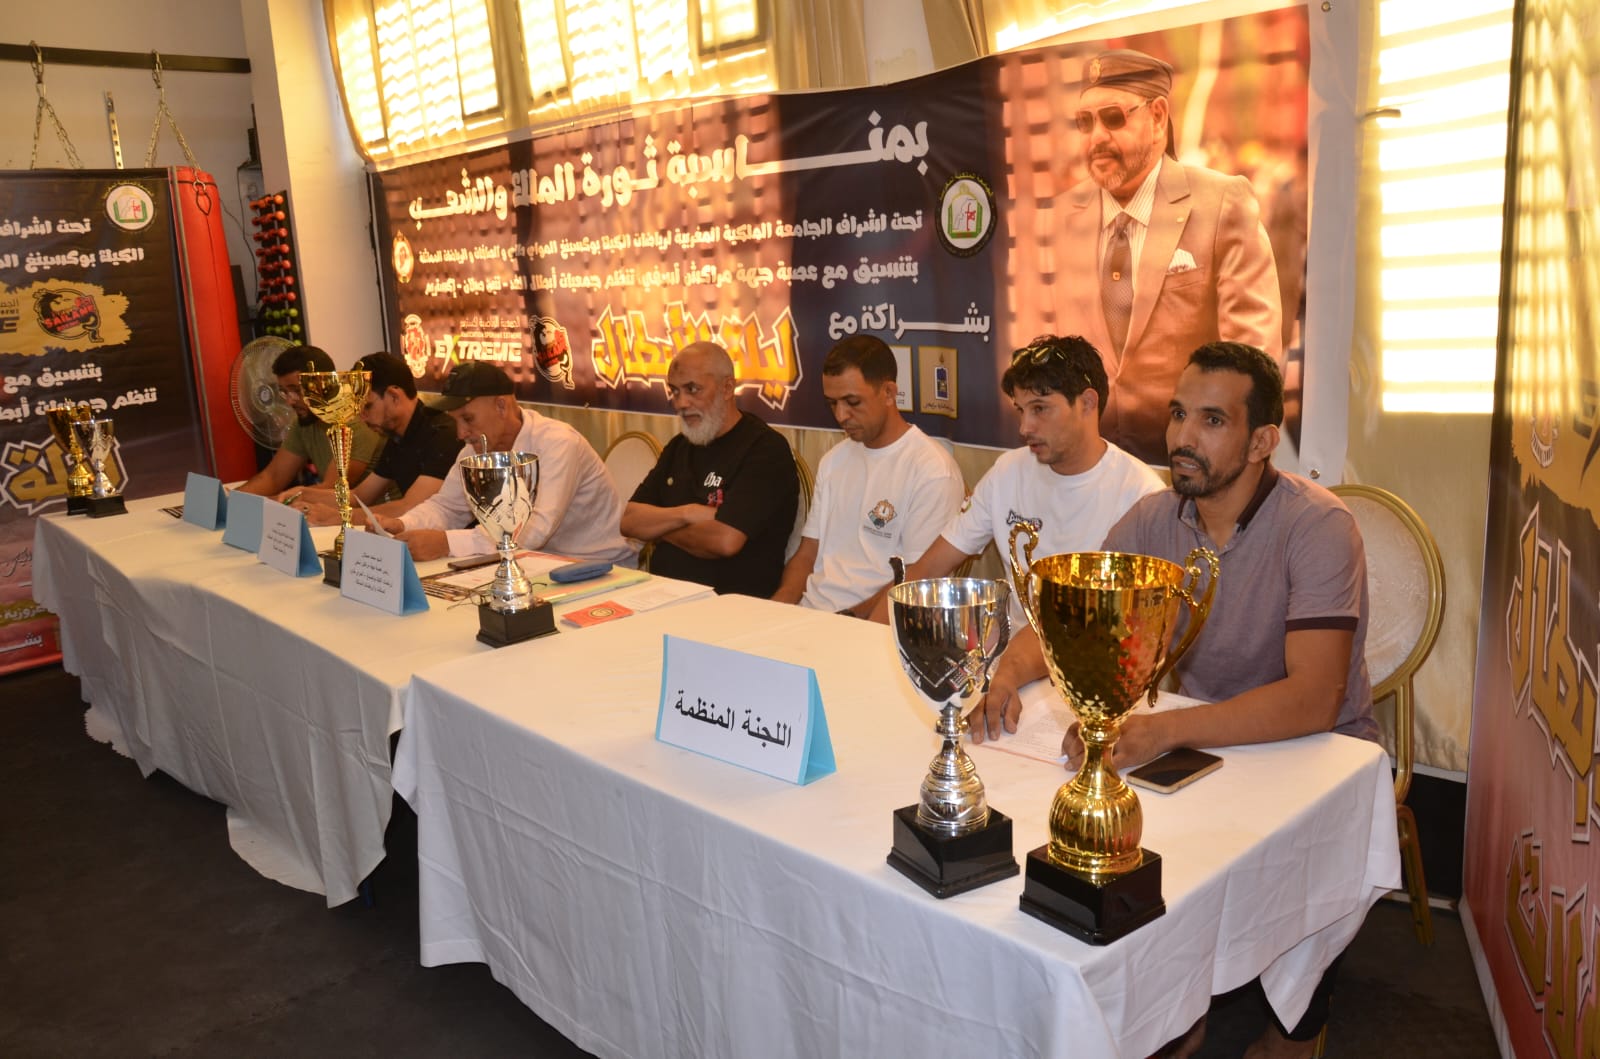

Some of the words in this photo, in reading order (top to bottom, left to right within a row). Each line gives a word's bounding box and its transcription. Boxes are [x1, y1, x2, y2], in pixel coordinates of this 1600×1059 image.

[581, 134, 660, 207] ثورة
[511, 162, 575, 207] الملك
[409, 167, 508, 231] والشعب
[56, 218, 92, 234] تحت
[775, 217, 832, 240] الجامعة
[836, 208, 887, 238] اشراف
[891, 209, 923, 230] تحت
[601, 233, 631, 253] الكيك
[633, 230, 672, 250] لرياضات
[674, 225, 721, 249] المغربية
[723, 222, 773, 246] الملكية
[100, 248, 145, 266] الكيك
[560, 236, 600, 260] بوكسينغ
[25, 250, 96, 273] بوكسينغ
[852, 256, 919, 284] بتنسيق
[559, 272, 601, 293] جمعيات
[604, 268, 635, 290] تنظم
[684, 260, 733, 288] مراكش
[736, 262, 774, 289] جهة
[777, 261, 818, 287] عصبة
[822, 264, 848, 289] مع
[828, 311, 858, 340] مع
[3, 373, 32, 394] مع
[36, 362, 103, 388] بتنسيق
[112, 387, 157, 410] تنظم
[675, 690, 735, 731] المنظمة
[742, 709, 791, 748] اللجنة
